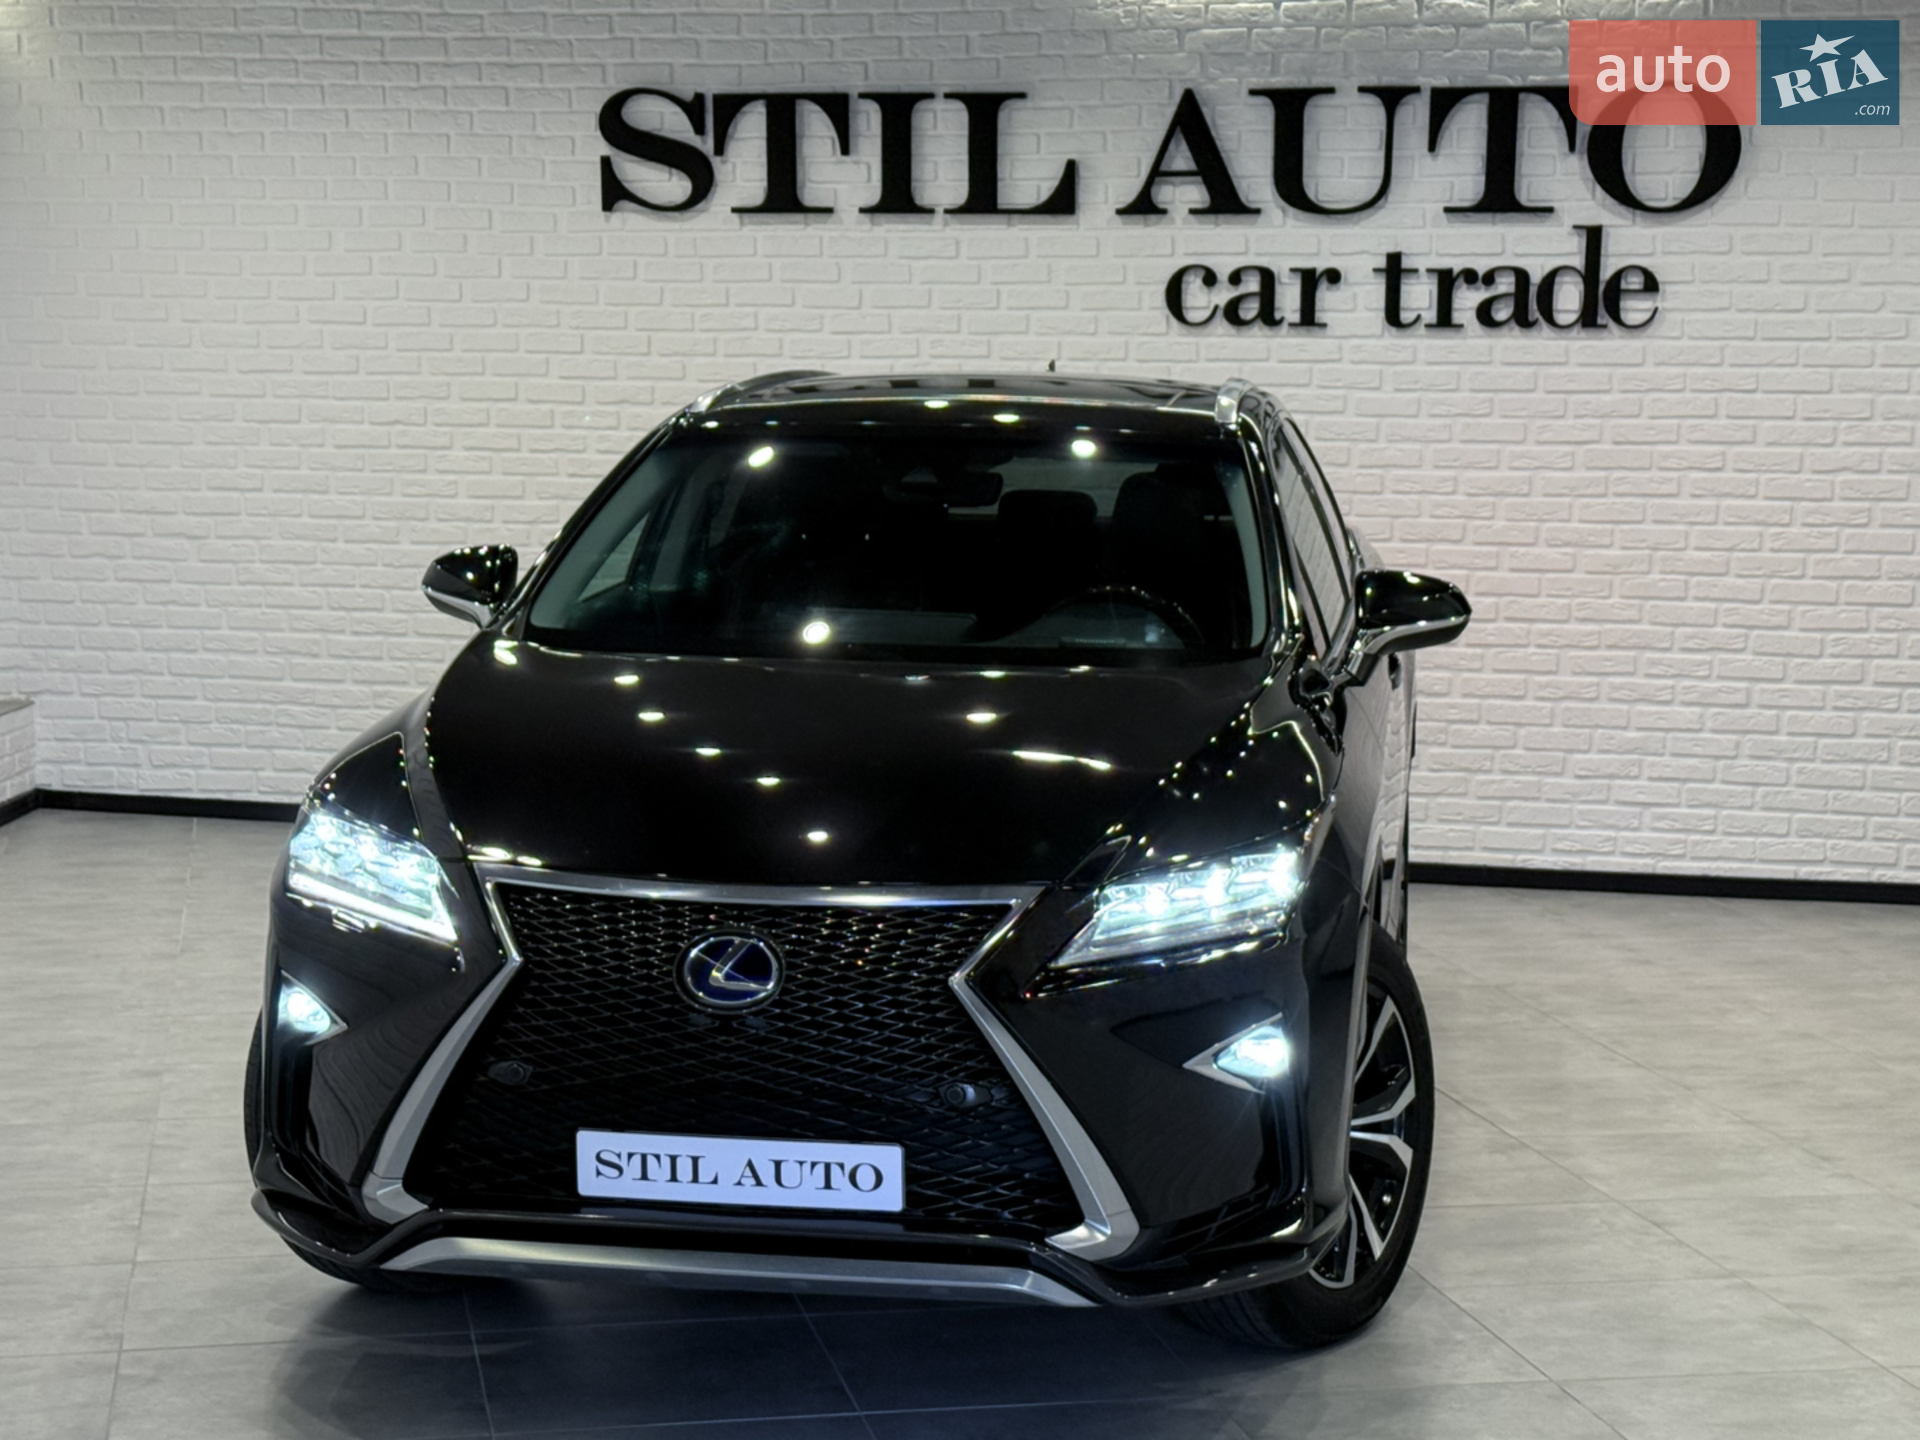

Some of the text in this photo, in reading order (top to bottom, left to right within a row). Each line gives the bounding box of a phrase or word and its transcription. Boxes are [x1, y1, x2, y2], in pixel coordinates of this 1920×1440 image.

[598, 83, 1742, 215] STIL AUTO
[1165, 224, 1660, 330] car trade
[594, 1149, 884, 1192] STIL AUTO
